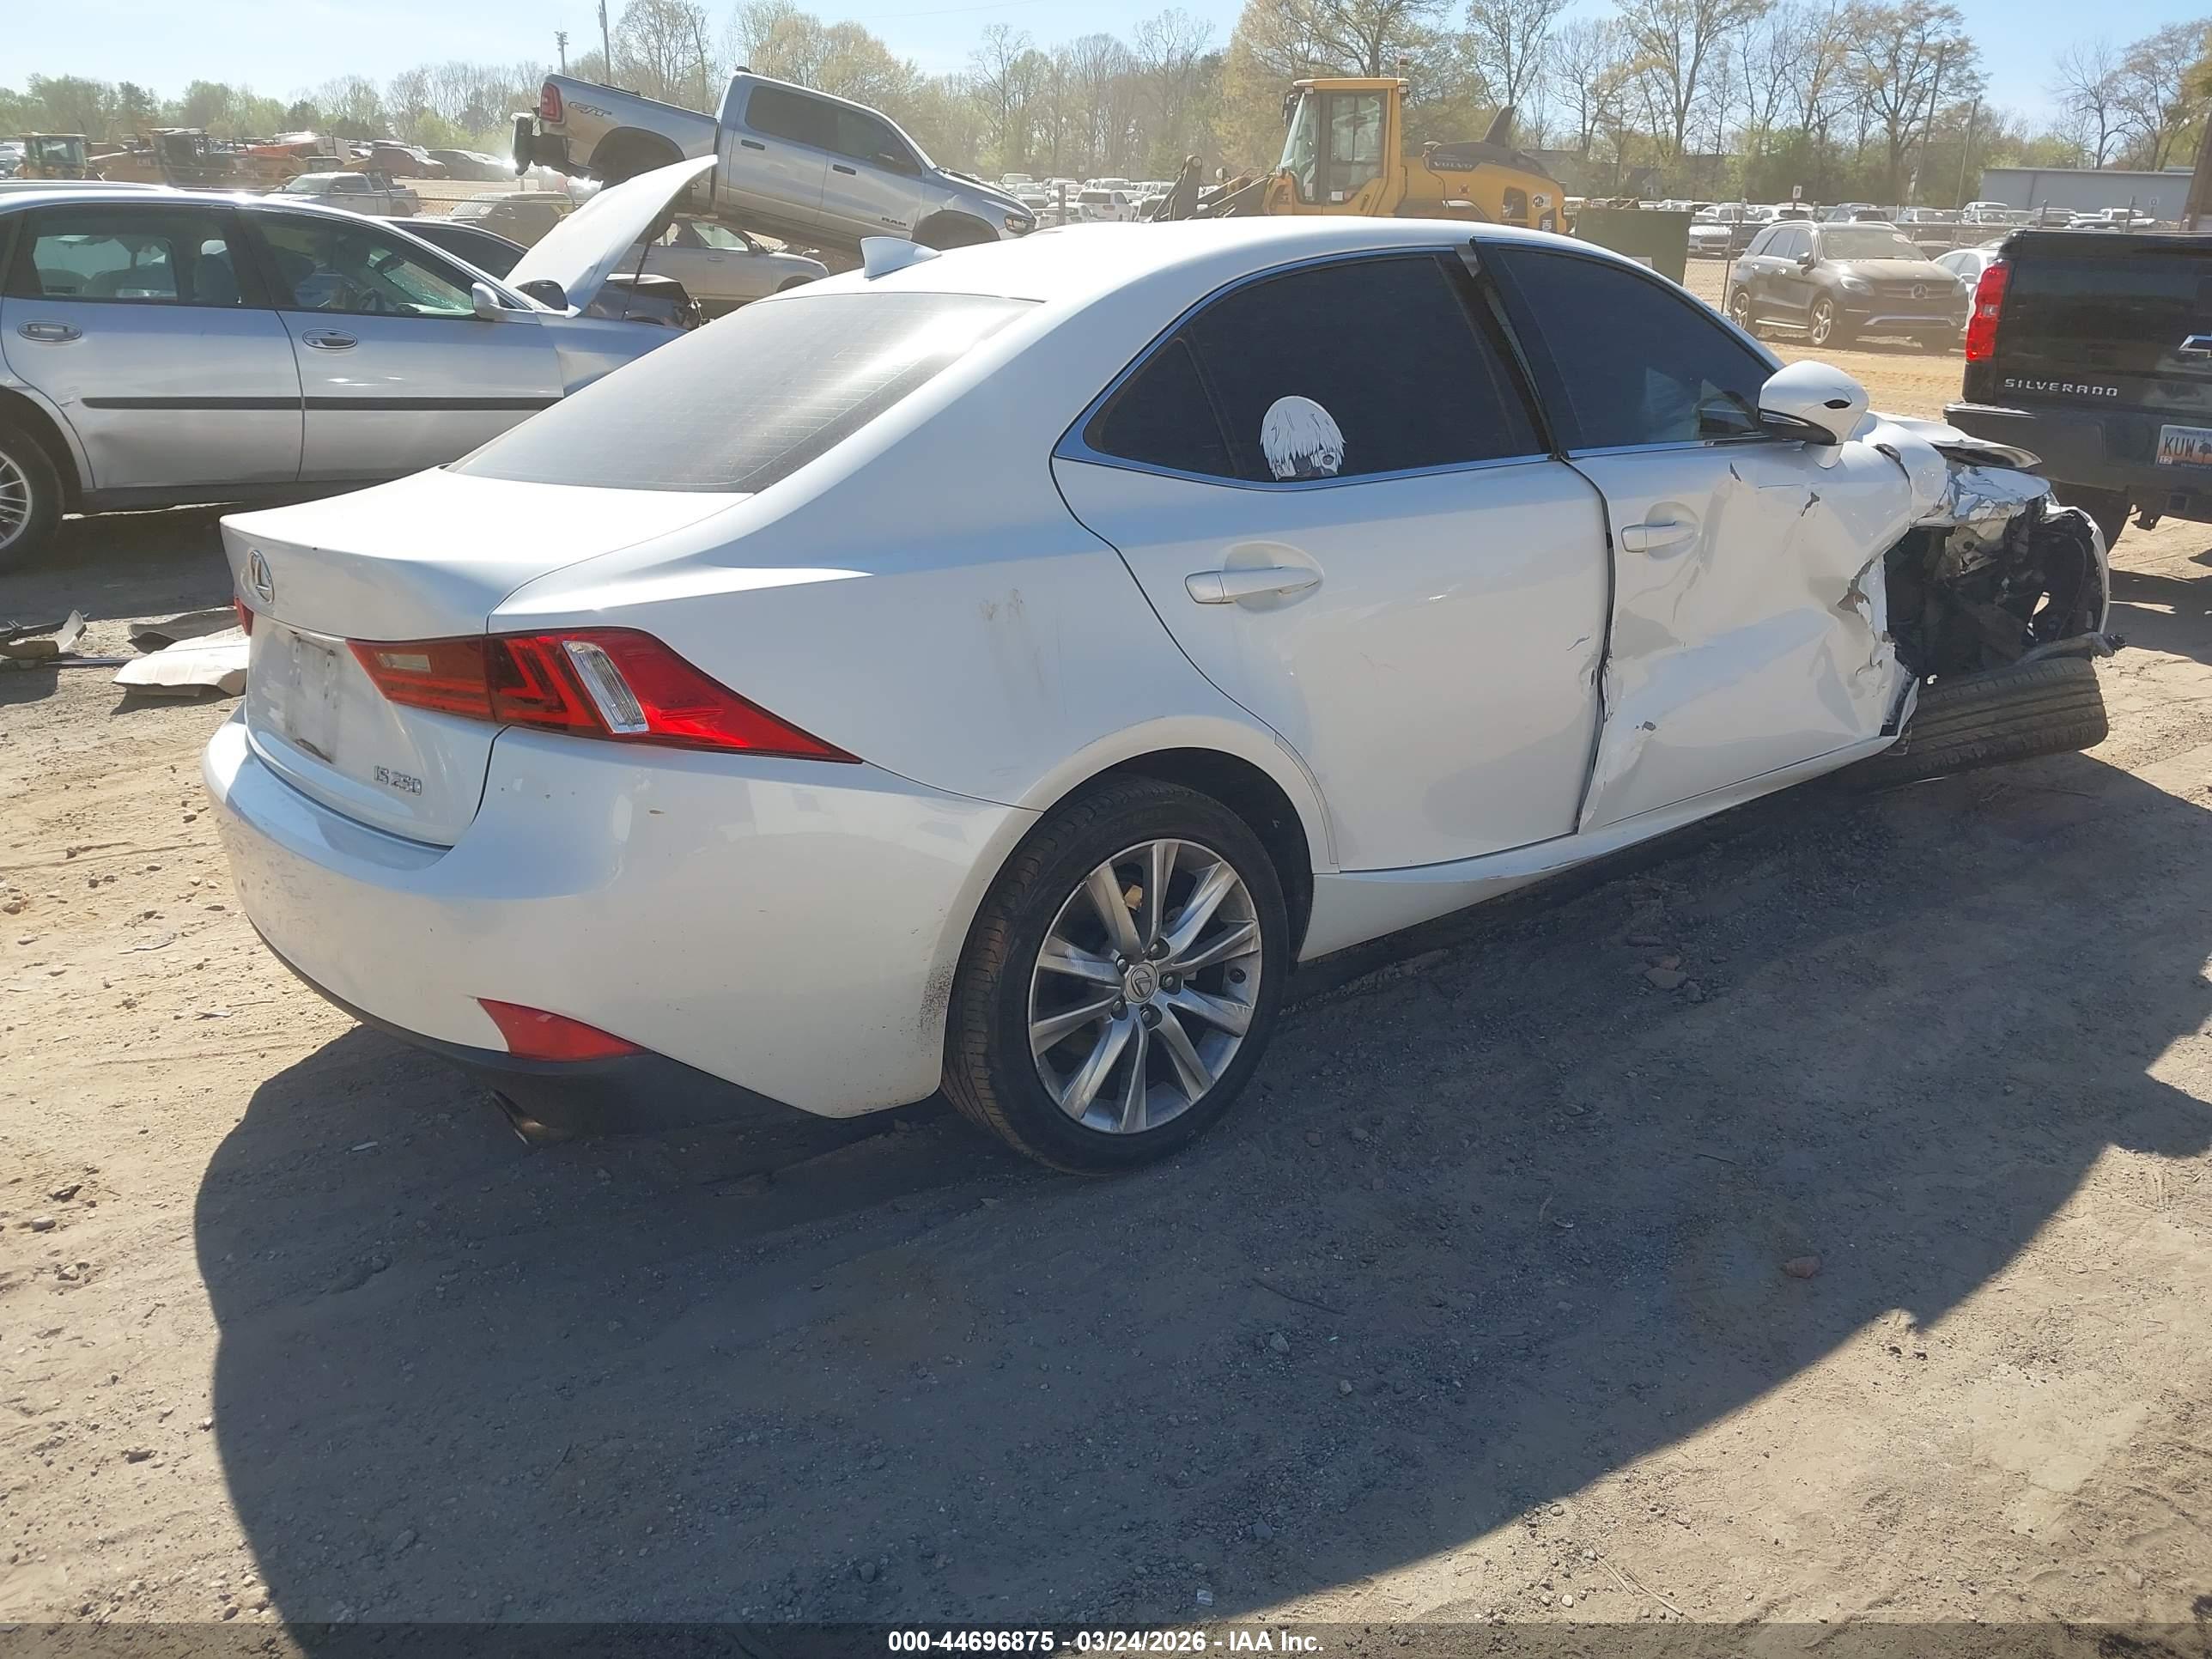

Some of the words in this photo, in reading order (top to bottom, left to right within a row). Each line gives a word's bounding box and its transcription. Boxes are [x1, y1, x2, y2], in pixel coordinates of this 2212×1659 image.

[881, 216, 907, 227] RAM
[2004, 378, 2118, 396] SILVERADO
[374, 765, 390, 784] IS
[391, 771, 422, 796] 250
